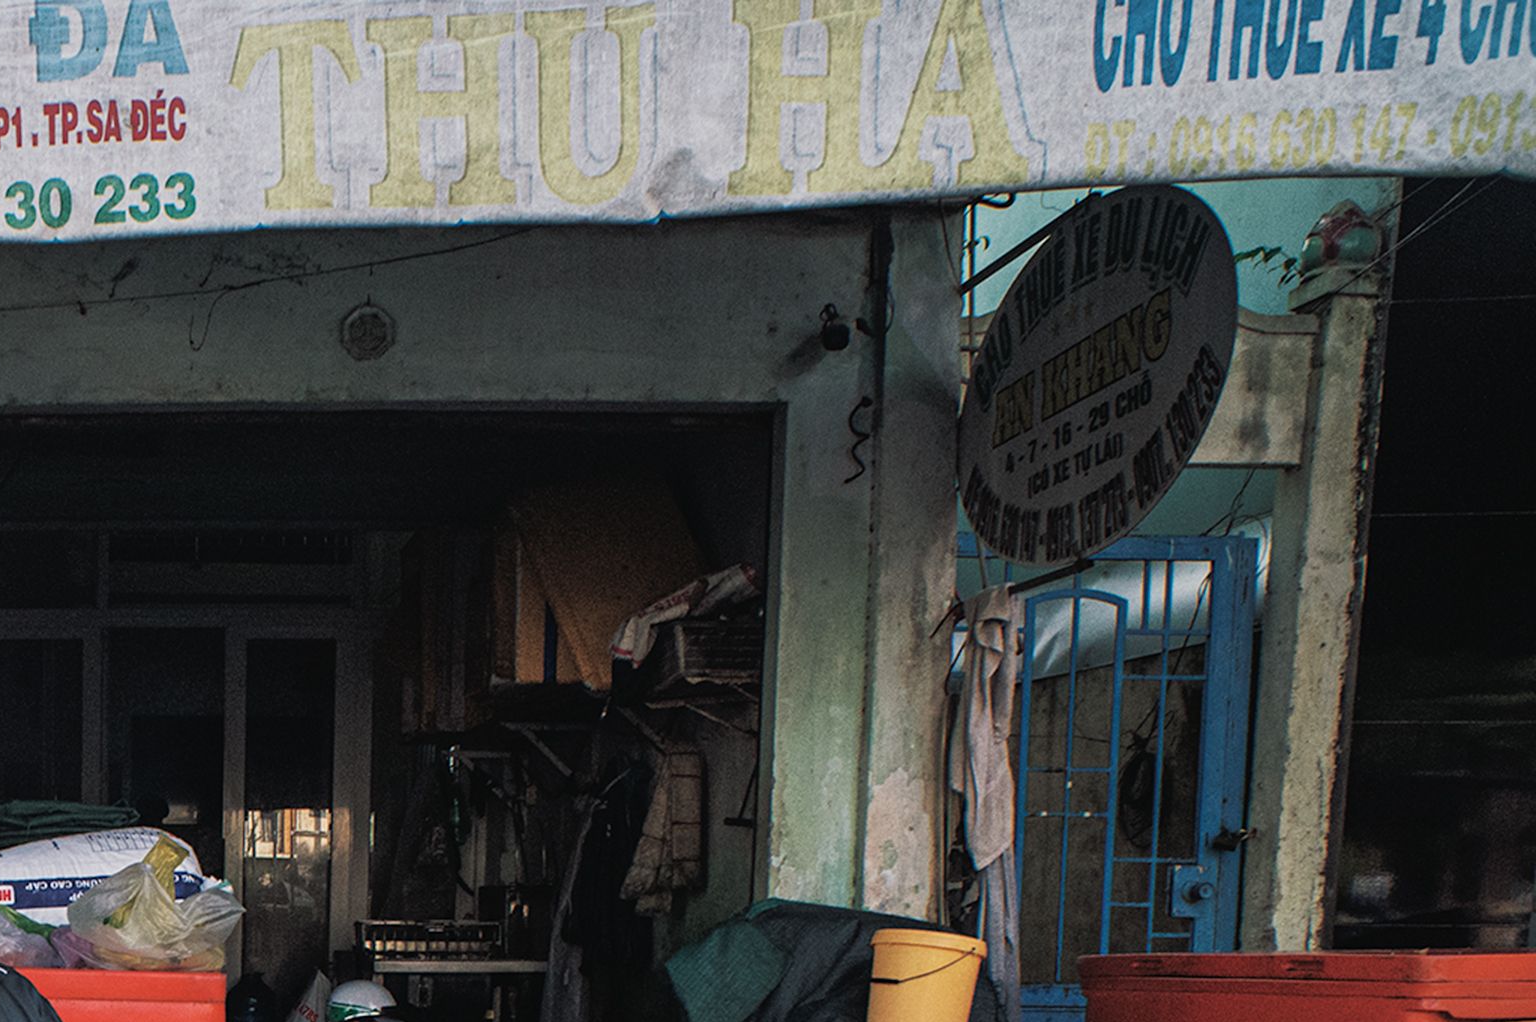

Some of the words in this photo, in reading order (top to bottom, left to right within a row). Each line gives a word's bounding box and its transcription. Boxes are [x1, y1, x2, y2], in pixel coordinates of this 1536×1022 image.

[130, 89, 186, 142] ĐÉC
[1168, 112, 1258, 178] 0916
[1268, 106, 1337, 171] 630
[1352, 101, 1418, 164] 147
[94, 171, 197, 225] 233
[992, 370, 1037, 450] AN
[1041, 287, 1173, 423] KHANG
[1027, 439, 1038, 465] 7
[1052, 429, 1072, 454] 16
[1088, 402, 1110, 434] 29
[1052, 460, 1070, 490] XE
